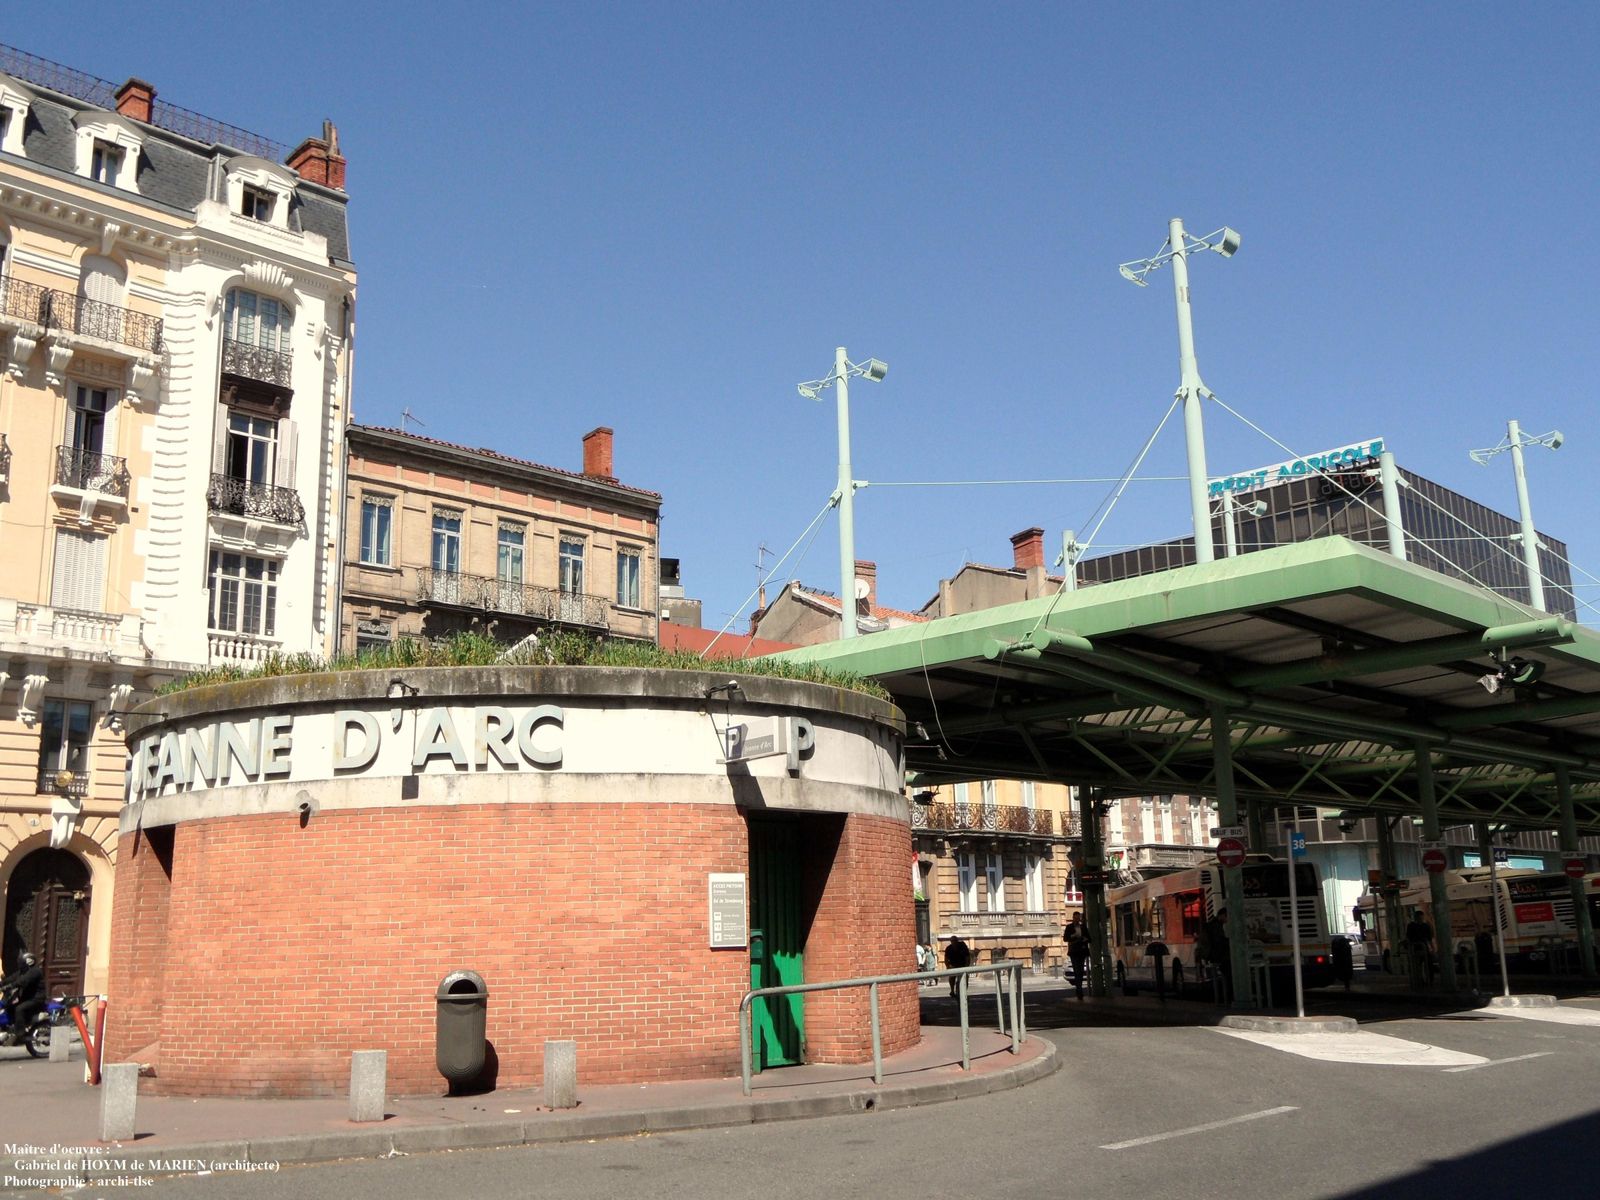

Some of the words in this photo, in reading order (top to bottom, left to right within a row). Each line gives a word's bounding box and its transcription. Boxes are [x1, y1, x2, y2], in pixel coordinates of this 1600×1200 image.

[728, 728, 740, 758] P
[132, 714, 292, 794] JEANNE
[333, 704, 565, 771] D'ARC
[1230, 828, 1243, 836] BUS
[1292, 839, 1305, 850] 38
[1495, 850, 1507, 859] 44
